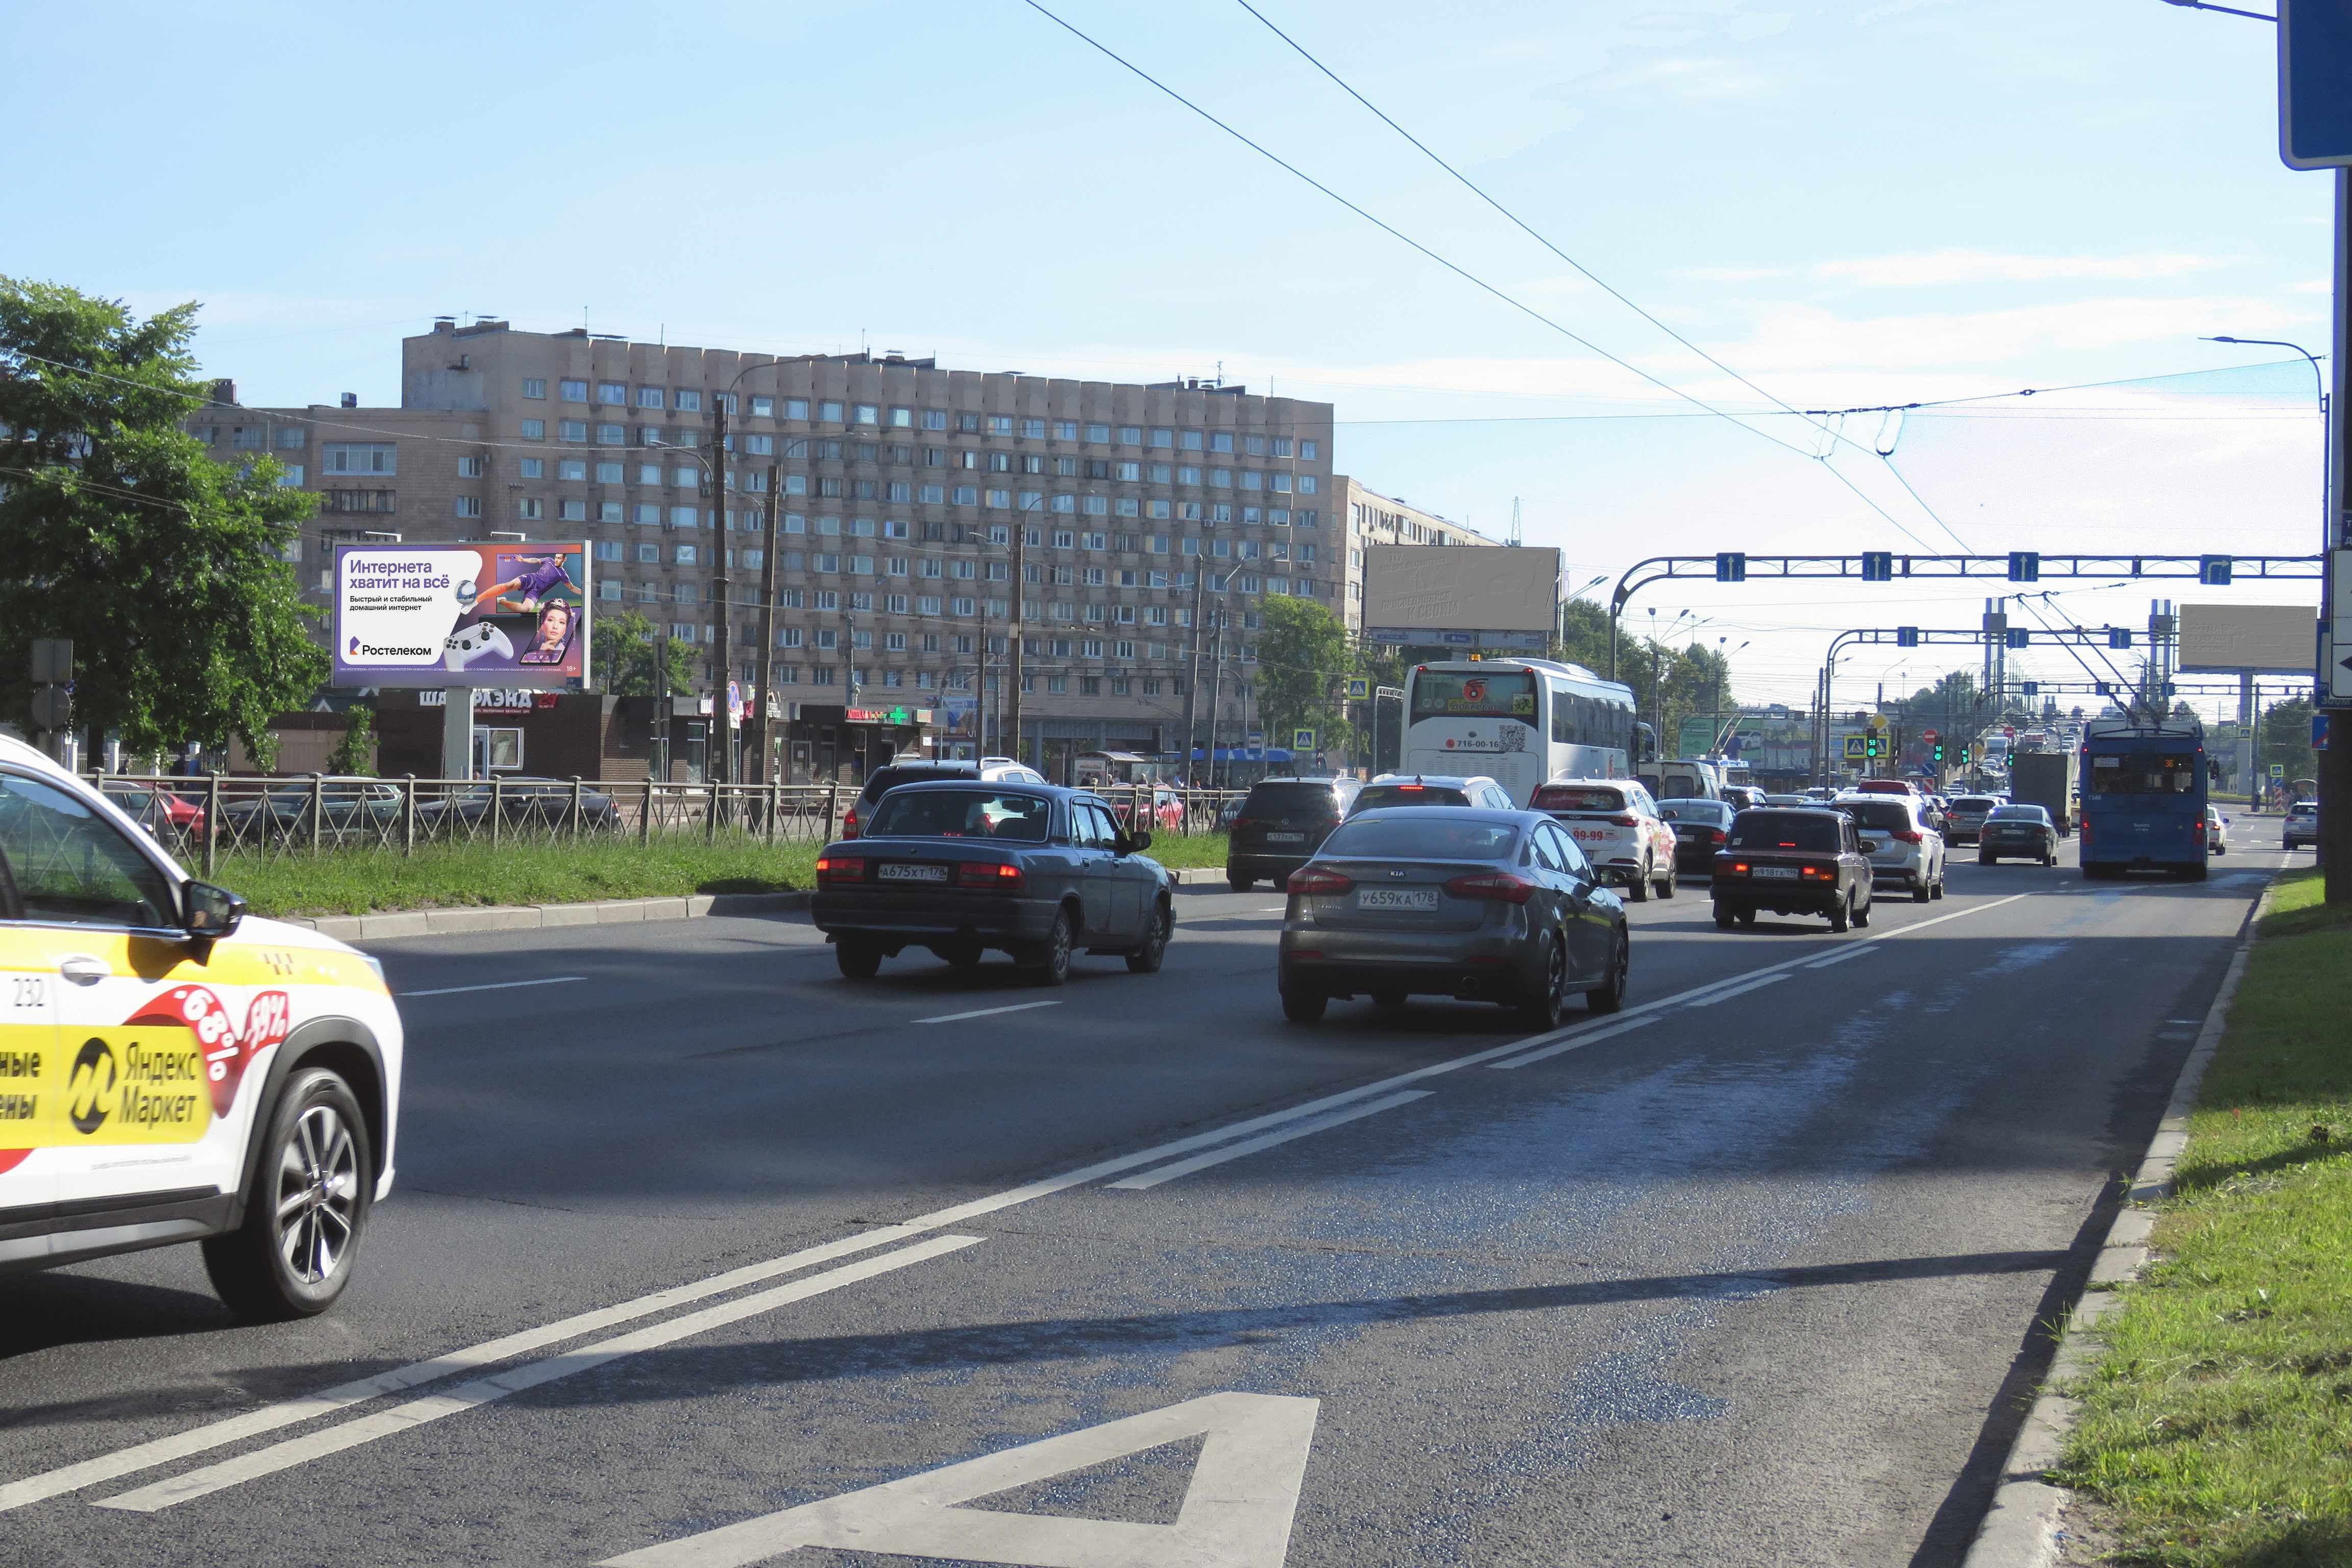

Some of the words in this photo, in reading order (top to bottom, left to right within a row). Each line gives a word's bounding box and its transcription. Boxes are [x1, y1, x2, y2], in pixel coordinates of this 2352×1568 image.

[351, 560, 432, 577] Интернета
[350, 578, 399, 589] хватит
[403, 578, 420, 589] на
[424, 574, 450, 589] всё
[362, 645, 431, 655] Ростелеком
[882, 865, 924, 878] А675ХТ
[930, 866, 944, 876] 178
[1362, 892, 1411, 905] У659КА
[1415, 891, 1434, 902] 178
[12, 978, 44, 1006] 232
[124, 1042, 199, 1086] Яндекс
[118, 1086, 197, 1131] Маркет
